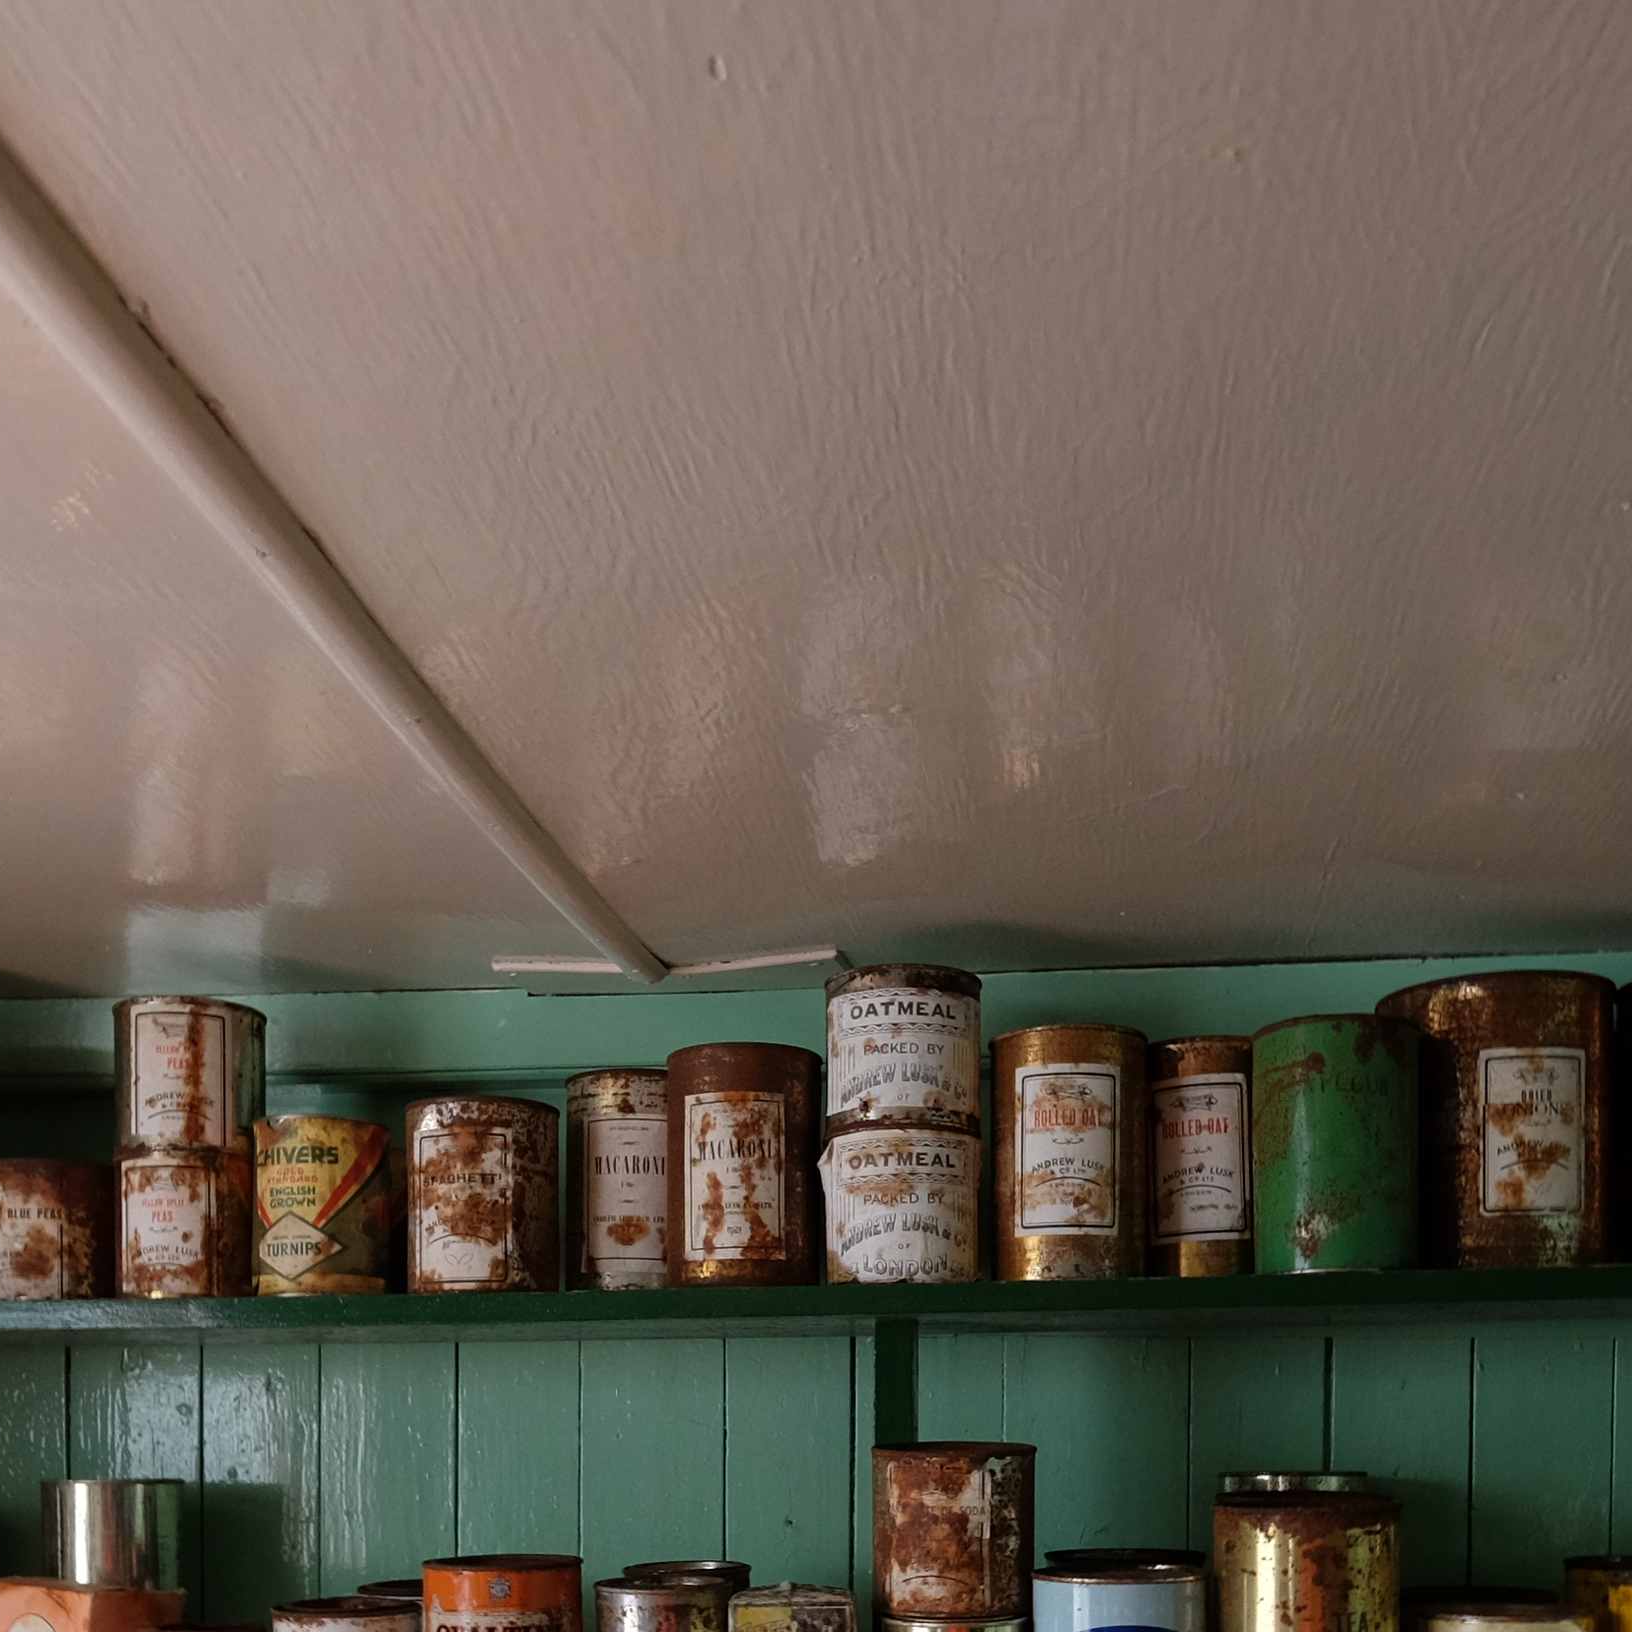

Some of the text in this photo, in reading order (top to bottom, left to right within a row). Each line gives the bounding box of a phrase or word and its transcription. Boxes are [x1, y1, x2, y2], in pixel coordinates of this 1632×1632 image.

[850, 1001, 957, 1020] OATMEAL
[863, 1043, 945, 1056] PACKED BY
[840, 1063, 896, 1108] ANDREW
[901, 1062, 940, 1089] LUSK
[1521, 1089, 1553, 1101] DRIED
[1034, 1108, 1076, 1128] ROLLED
[1161, 1118, 1202, 1141] ROLLED
[257, 1145, 339, 1167] CHIVERS
[698, 1139, 774, 1161] MACARONI
[595, 1155, 666, 1176] MACARONI
[848, 1152, 956, 1170] OATMEAL
[1031, 1156, 1106, 1174] ANDREW LUSK
[276, 1167, 305, 1176] GOLD
[423, 1172, 502, 1187] SPAGHETTI
[1162, 1166, 1235, 1185] ANDREW LUSK
[267, 1175, 318, 1186] STANDARD
[269, 1186, 316, 1197] ENGLISH
[863, 1192, 945, 1206] PACKED BY
[269, 1198, 316, 1209] GROWN
[7, 1208, 32, 1219] BLUE
[37, 1207, 63, 1220] PEAS
[151, 1210, 173, 1223] PEAS
[841, 1213, 896, 1257] ANDREW
[902, 1212, 940, 1237] LUSK
[266, 1242, 322, 1257] TURNIPS
[862, 1253, 948, 1277] LONDON
[960, 1505, 986, 1516] SODA
